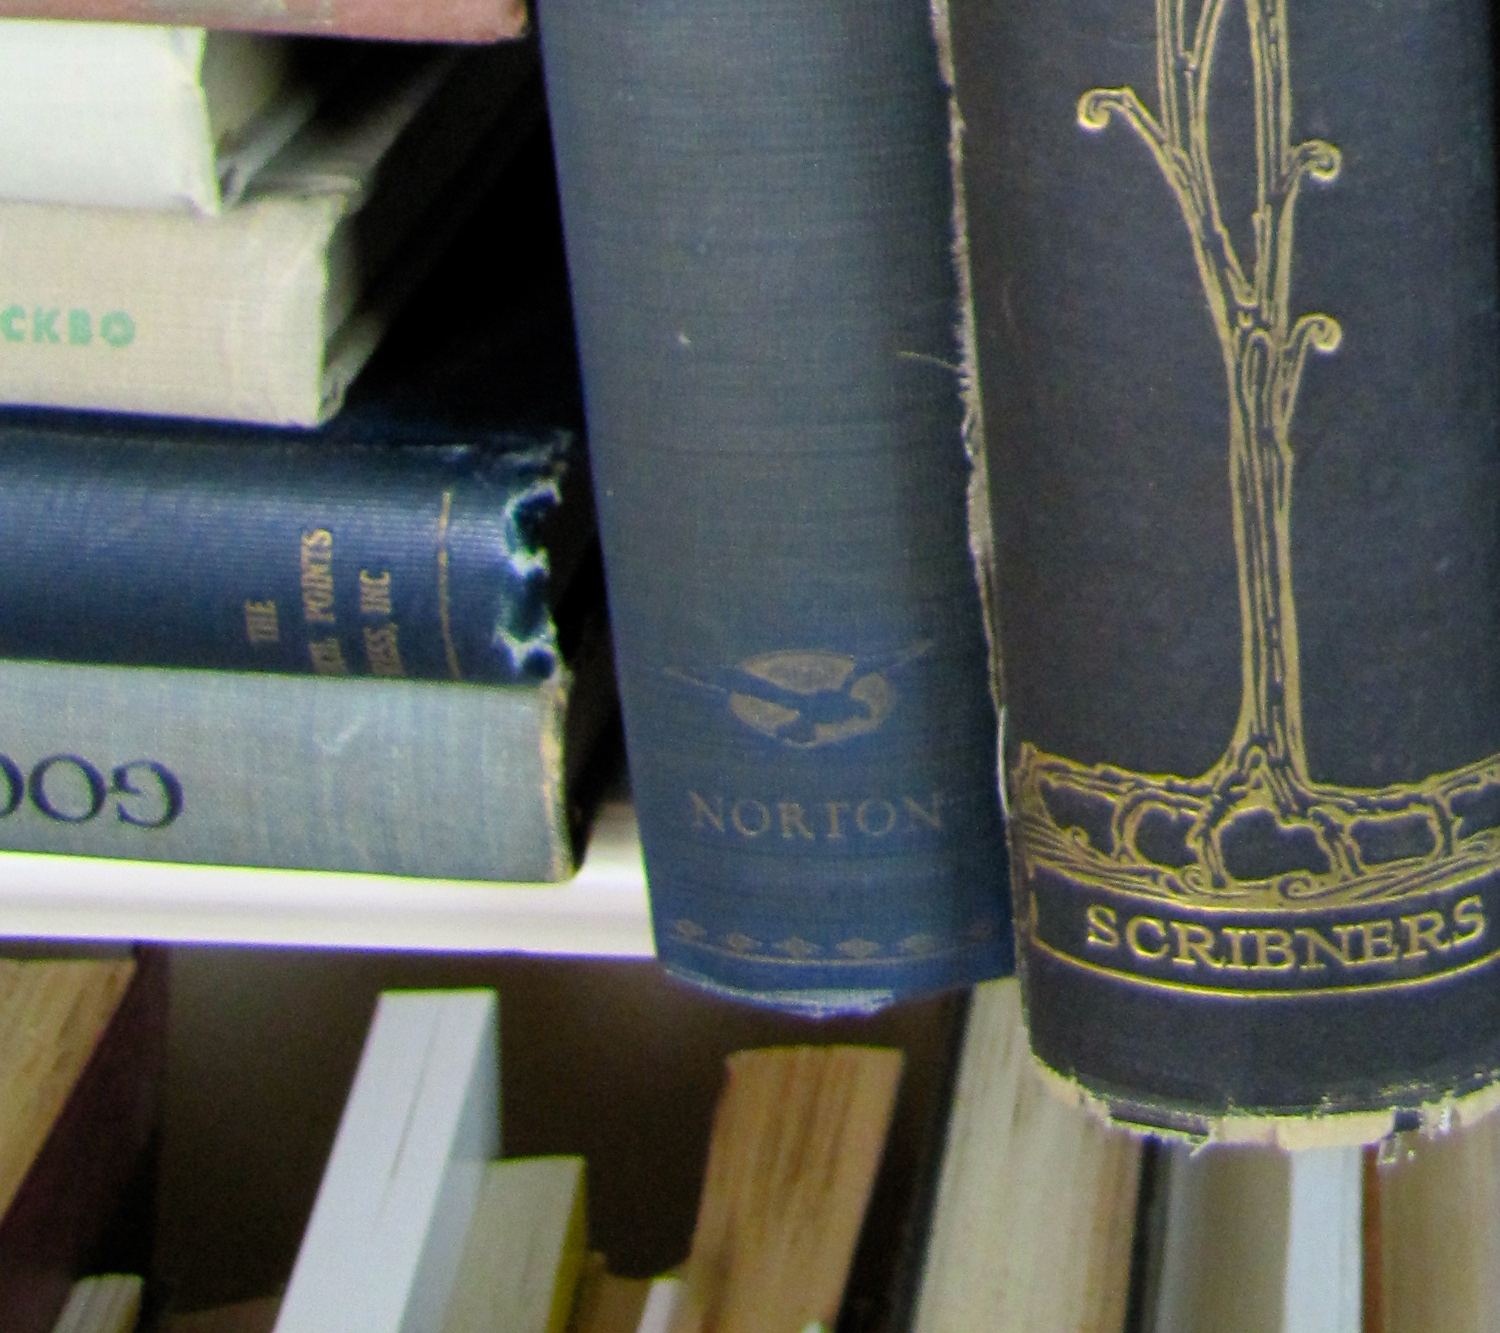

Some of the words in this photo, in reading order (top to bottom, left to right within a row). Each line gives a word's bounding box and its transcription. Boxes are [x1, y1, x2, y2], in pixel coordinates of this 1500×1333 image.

[300, 528, 336, 623] POINTS
[690, 789, 944, 841] NORTON
[1086, 894, 1487, 971] SCRIBNERS
